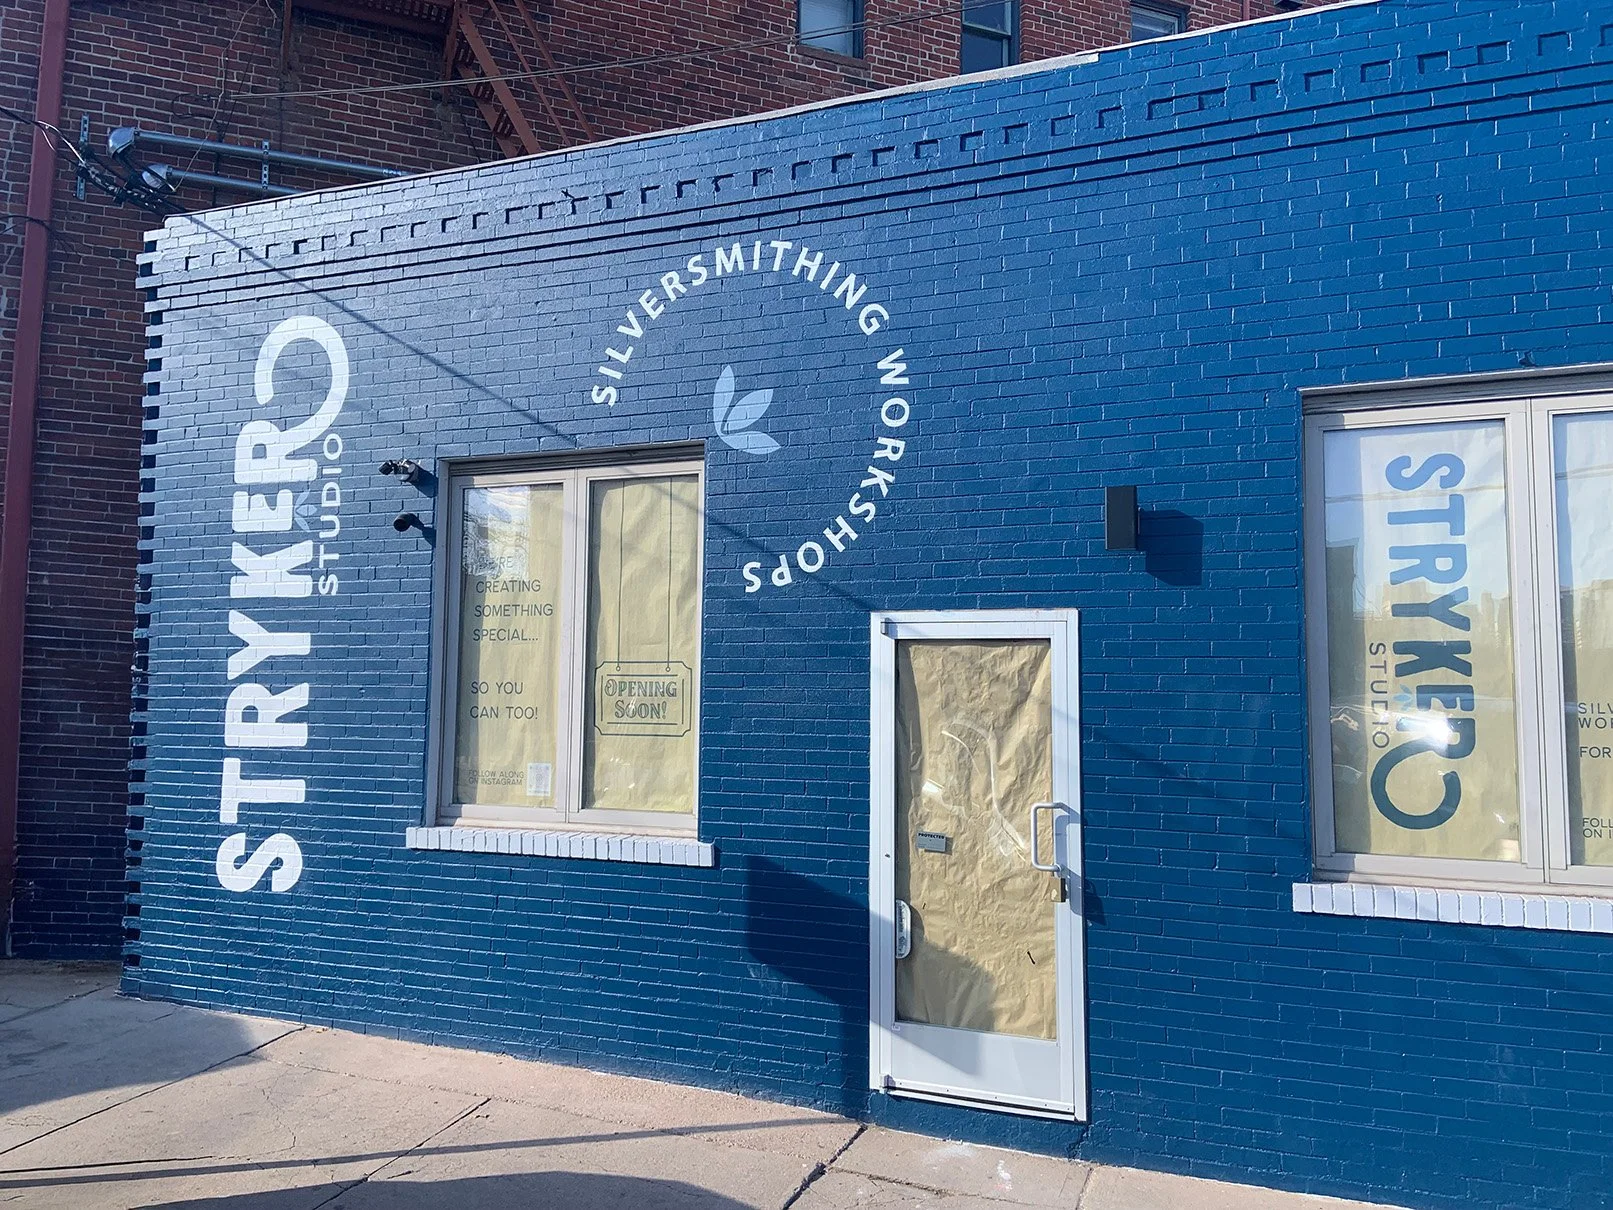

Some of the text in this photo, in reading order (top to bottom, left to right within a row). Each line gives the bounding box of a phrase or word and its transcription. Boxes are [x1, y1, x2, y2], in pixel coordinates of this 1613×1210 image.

[592, 241, 909, 593] SILVERSMITHING WORKSHOPS
[318, 433, 343, 596] STUDIO
[475, 579, 541, 593] CREATING
[216, 315, 349, 893] STRYKER
[474, 603, 553, 618] SOMETHING
[472, 628, 539, 641] SPECIAL...
[1371, 453, 1476, 829] STRYKER
[470, 682, 523, 695] SO YOU
[604, 679, 677, 698] OPENING
[1369, 642, 1390, 749] STUDIO
[469, 706, 538, 720] CAN TOO!
[614, 700, 667, 719] SOON!
[1578, 717, 1613, 729] WO
[1579, 746, 1611, 758] FOR
[468, 769, 525, 779] FOLLOW ALONG
[468, 776, 522, 786] ON INSTAGRAM
[1582, 828, 1602, 838] ON
